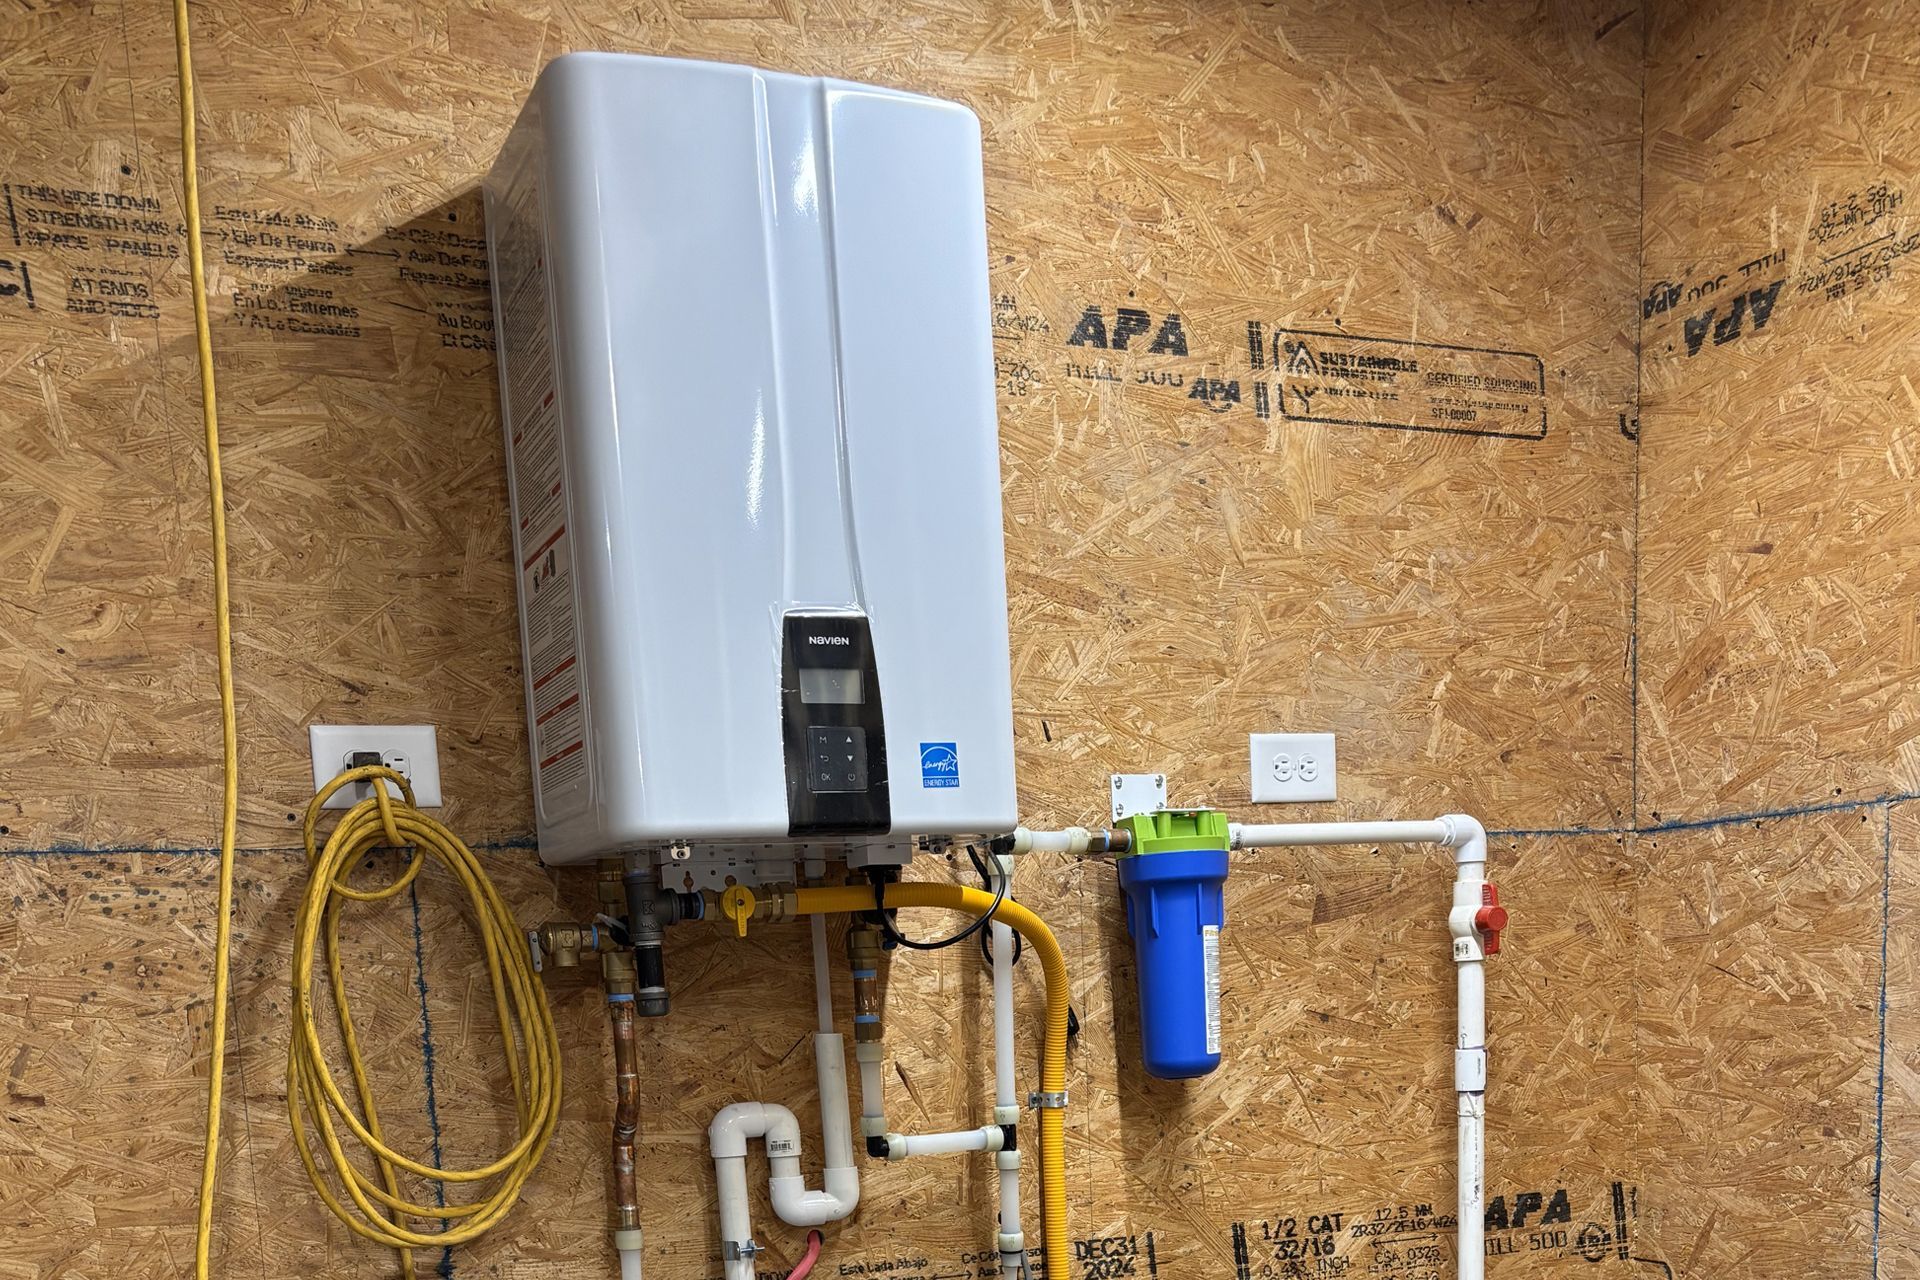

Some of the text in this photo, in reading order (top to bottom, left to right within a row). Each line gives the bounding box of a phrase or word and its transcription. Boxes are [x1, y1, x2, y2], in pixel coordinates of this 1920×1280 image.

[15, 184, 161, 214] THIS SIDE DOWN
[25, 208, 171, 237] STRENGTH AXIS
[72, 277, 149, 299] AT ENDS
[1066, 304, 1189, 357] APA
[1684, 279, 1787, 358] APA
[1187, 377, 1241, 403] APA
[1426, 370, 1538, 396] CERTIFIED SOURCING
[819, 736, 828, 744] M
[821, 772, 832, 781] OK
[924, 779, 944, 787] ENERGY
[1374, 1205, 1409, 1222] 12.5
[1484, 1189, 1571, 1231] APA
[1262, 1212, 1345, 1241] 1/2 CAT
[1074, 1235, 1140, 1261] DEC31
[1272, 1235, 1337, 1261] 32/16
[1407, 1245, 1441, 1260] 0325
[1529, 1230, 1568, 1251] 500
[839, 1262, 866, 1276] Este
[896, 1256, 929, 1271] Abajo
[1083, 1255, 1138, 1280] 2024
[1315, 1255, 1351, 1272] INCH
